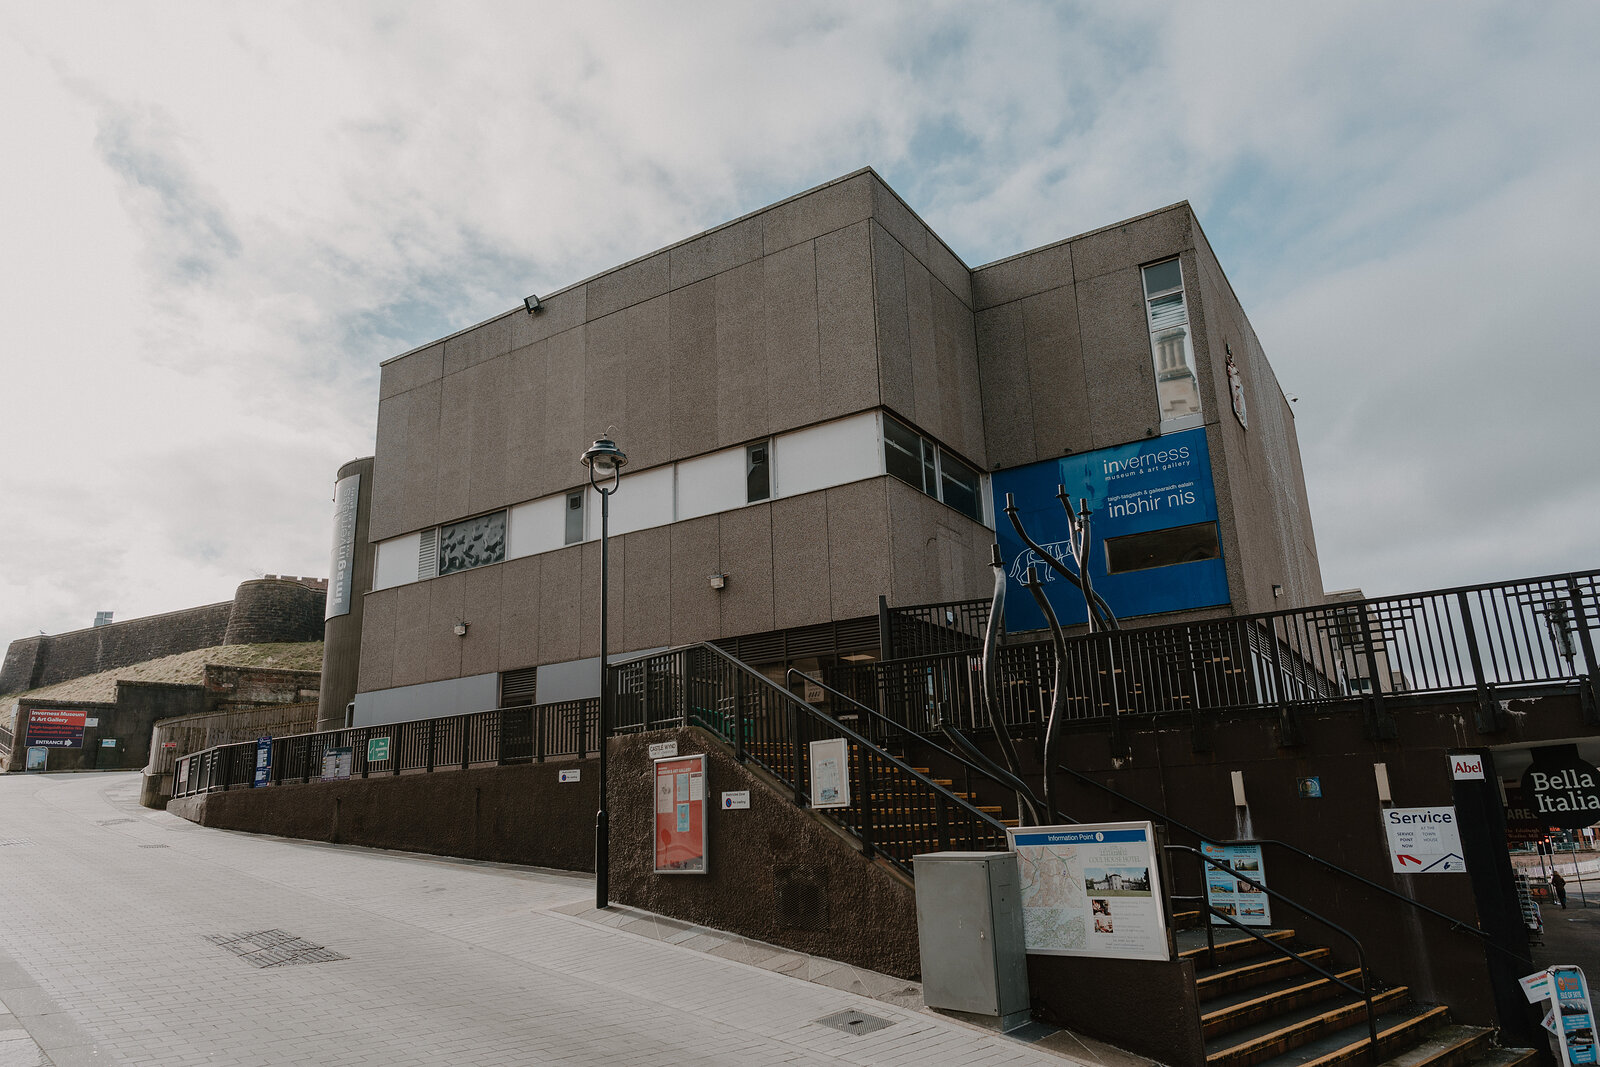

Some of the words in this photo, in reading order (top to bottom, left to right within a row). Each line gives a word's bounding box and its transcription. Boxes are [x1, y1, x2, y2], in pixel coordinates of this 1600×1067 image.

[1104, 446, 1190, 474] inverness
[1105, 471, 1136, 481] museum
[1162, 460, 1190, 470] gallery
[1108, 491, 1143, 502] taigh-tasgaidh
[1109, 496, 1161, 518] inbhir
[1168, 490, 1195, 508] nis
[1455, 761, 1482, 774] Abel
[1530, 769, 1595, 791] Bella
[1535, 791, 1600, 813] Italia
[1390, 811, 1452, 824] Service
